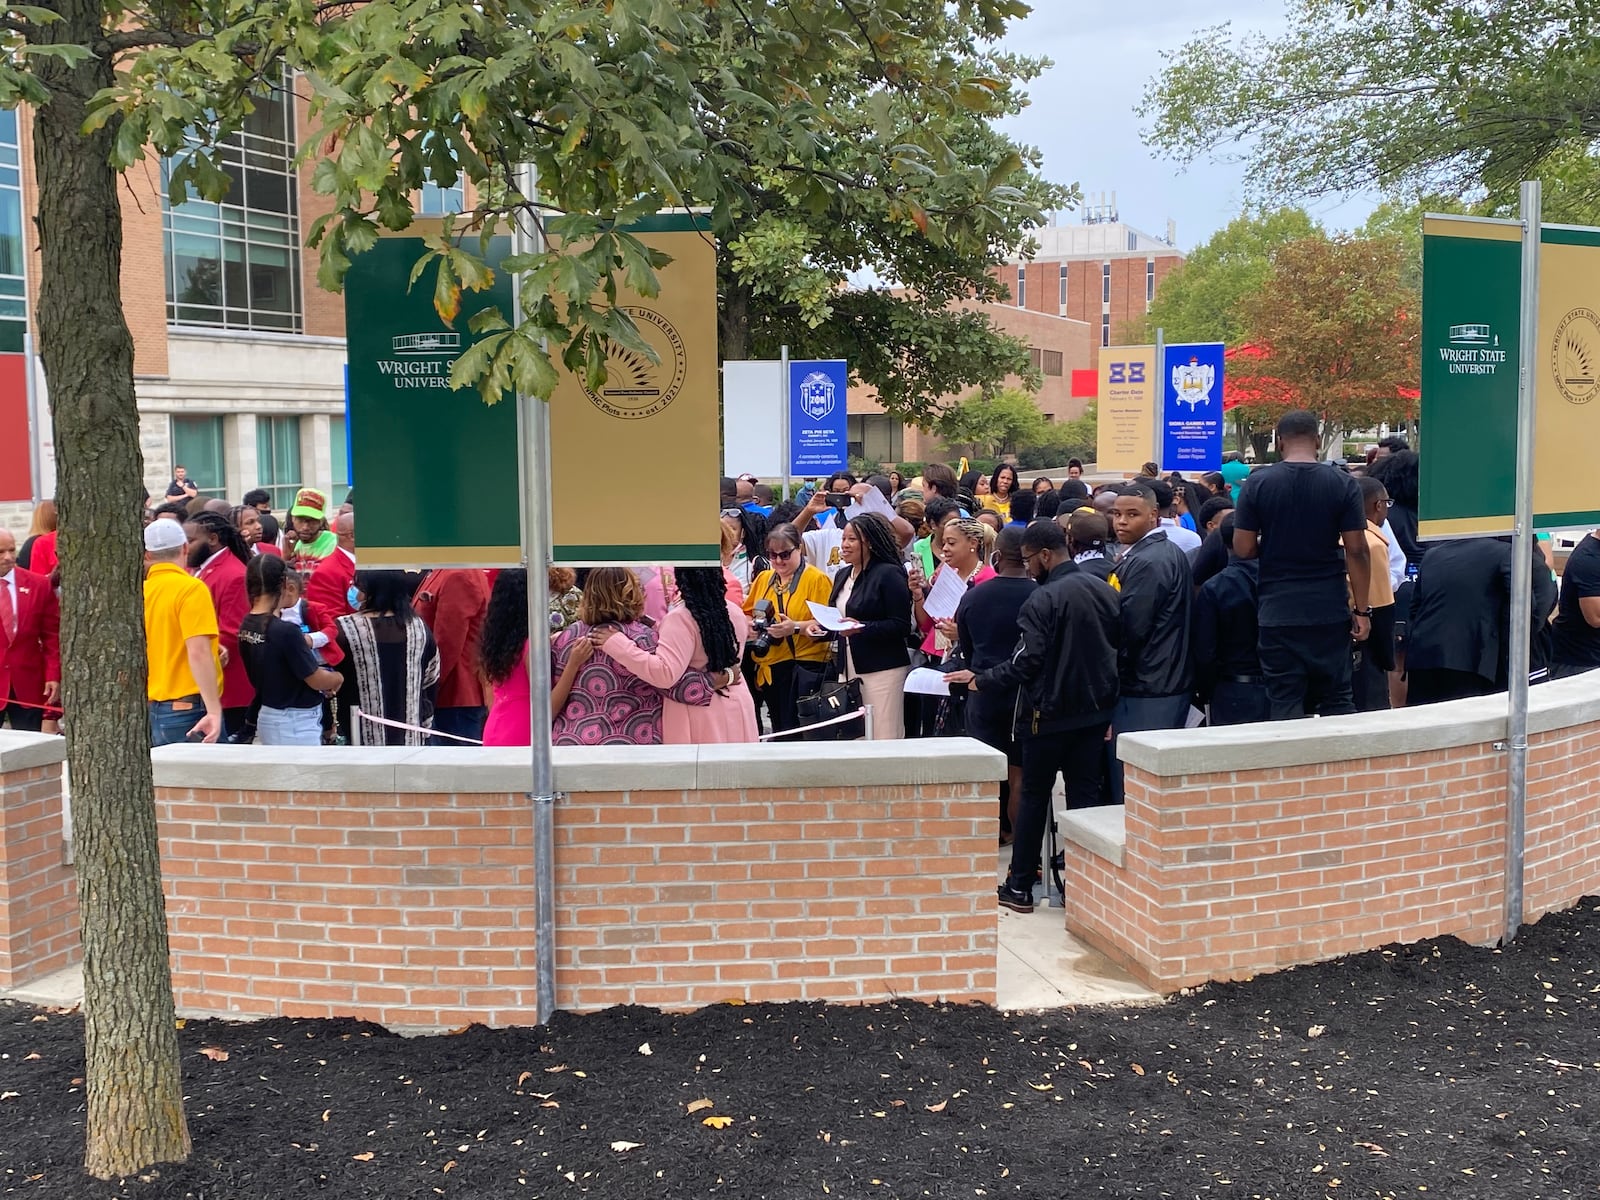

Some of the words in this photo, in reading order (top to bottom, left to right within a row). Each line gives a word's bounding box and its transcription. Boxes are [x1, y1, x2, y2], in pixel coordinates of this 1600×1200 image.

[639, 309, 684, 357] UNIVERSITY
[1440, 348, 1478, 362] WRIGHT
[1480, 349, 1506, 362] STATE
[377, 360, 442, 375] WRIGHT
[1449, 363, 1496, 374] UNIVERSITY
[660, 385, 679, 406] 2021
